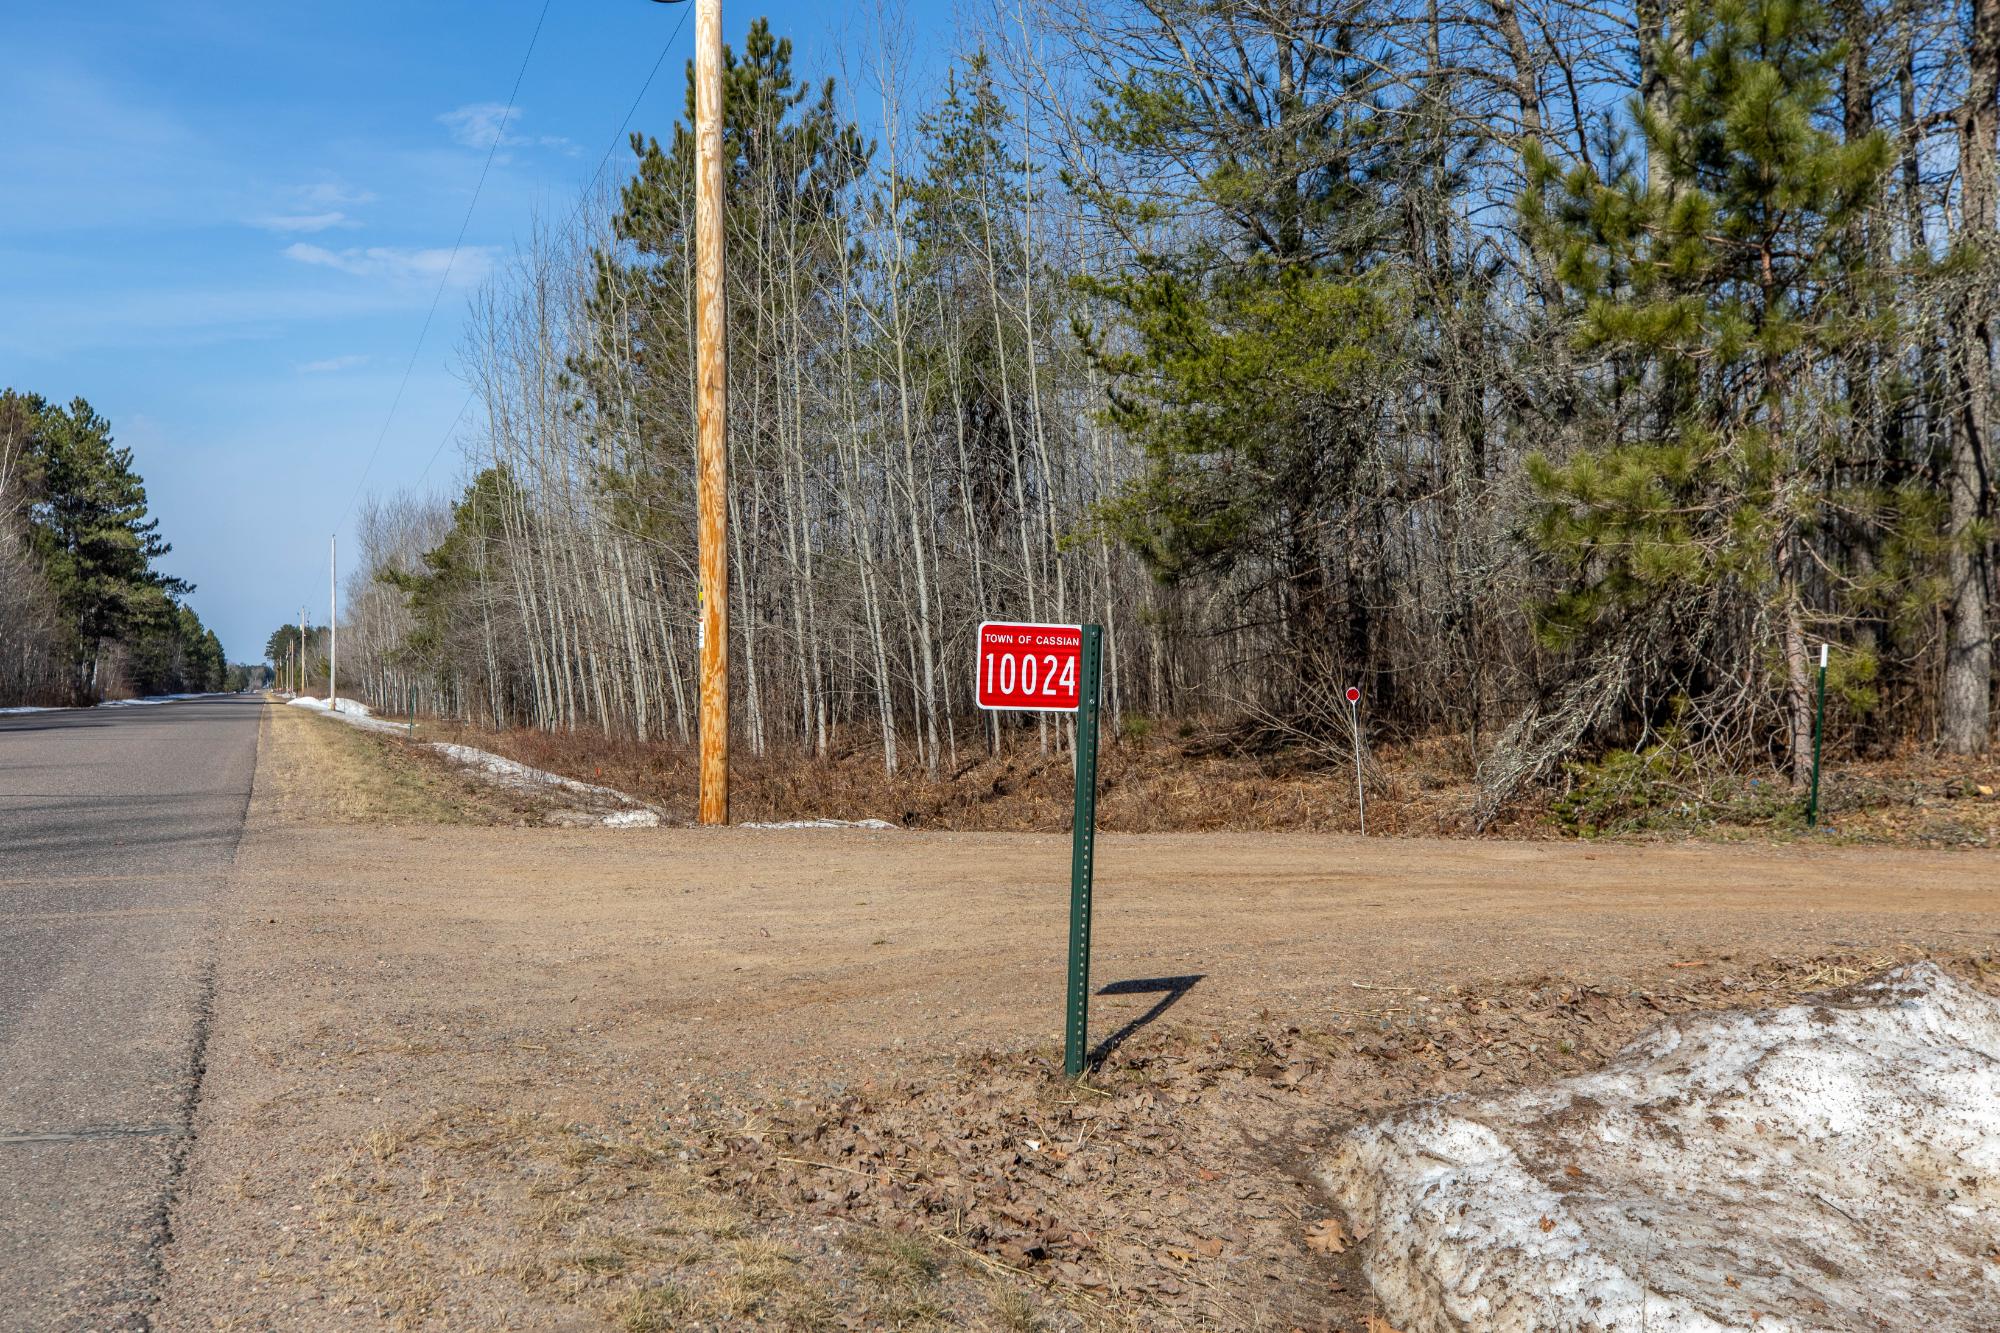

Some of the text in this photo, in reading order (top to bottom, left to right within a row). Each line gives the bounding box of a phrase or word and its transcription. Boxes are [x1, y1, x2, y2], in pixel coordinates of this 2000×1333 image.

[985, 633, 1079, 646] TOWN OF CASSIAN
[986, 653, 1075, 696] 10024
